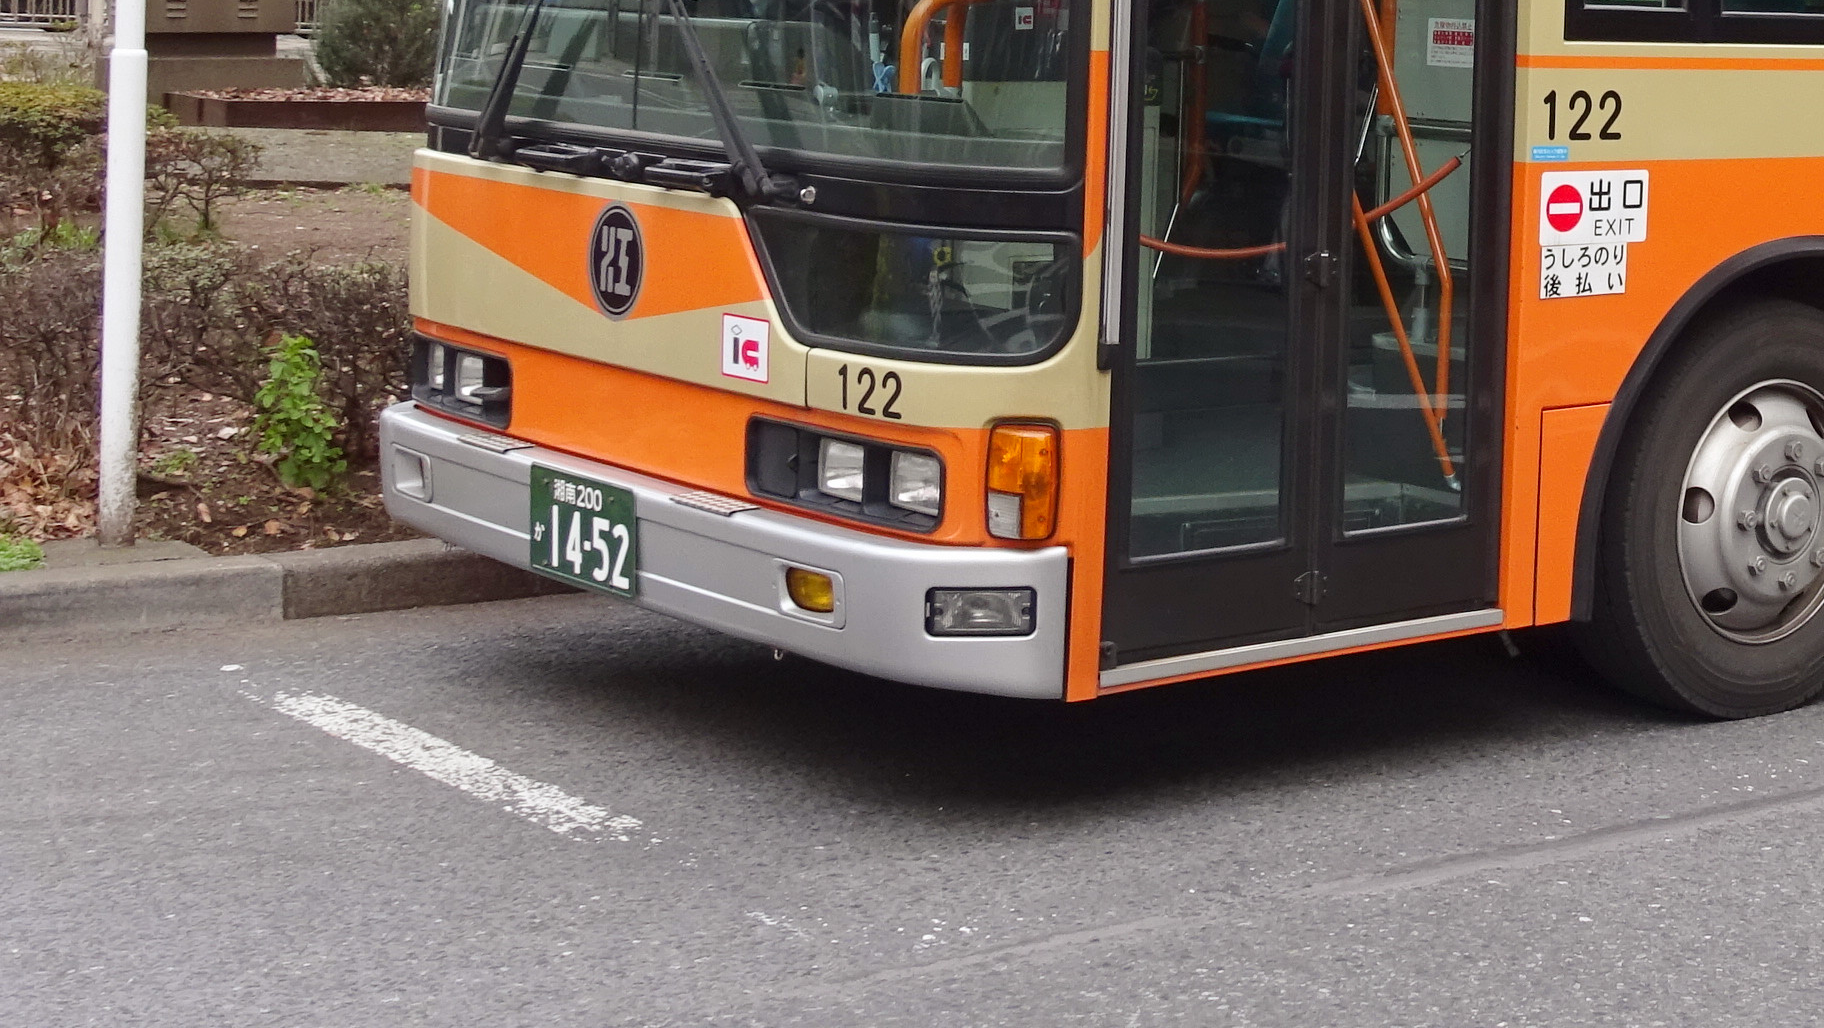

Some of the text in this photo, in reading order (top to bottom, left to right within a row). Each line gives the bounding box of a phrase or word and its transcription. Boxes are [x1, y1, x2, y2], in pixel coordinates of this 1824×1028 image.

[1543, 89, 1622, 140] 122
[1588, 178, 1643, 211] 出口
[1594, 218, 1635, 236] EXIT
[1543, 245, 1624, 270] うしろのり
[1543, 272, 1623, 297] 後払い
[838, 363, 902, 420] 122
[551, 504, 630, 590] 14-52
